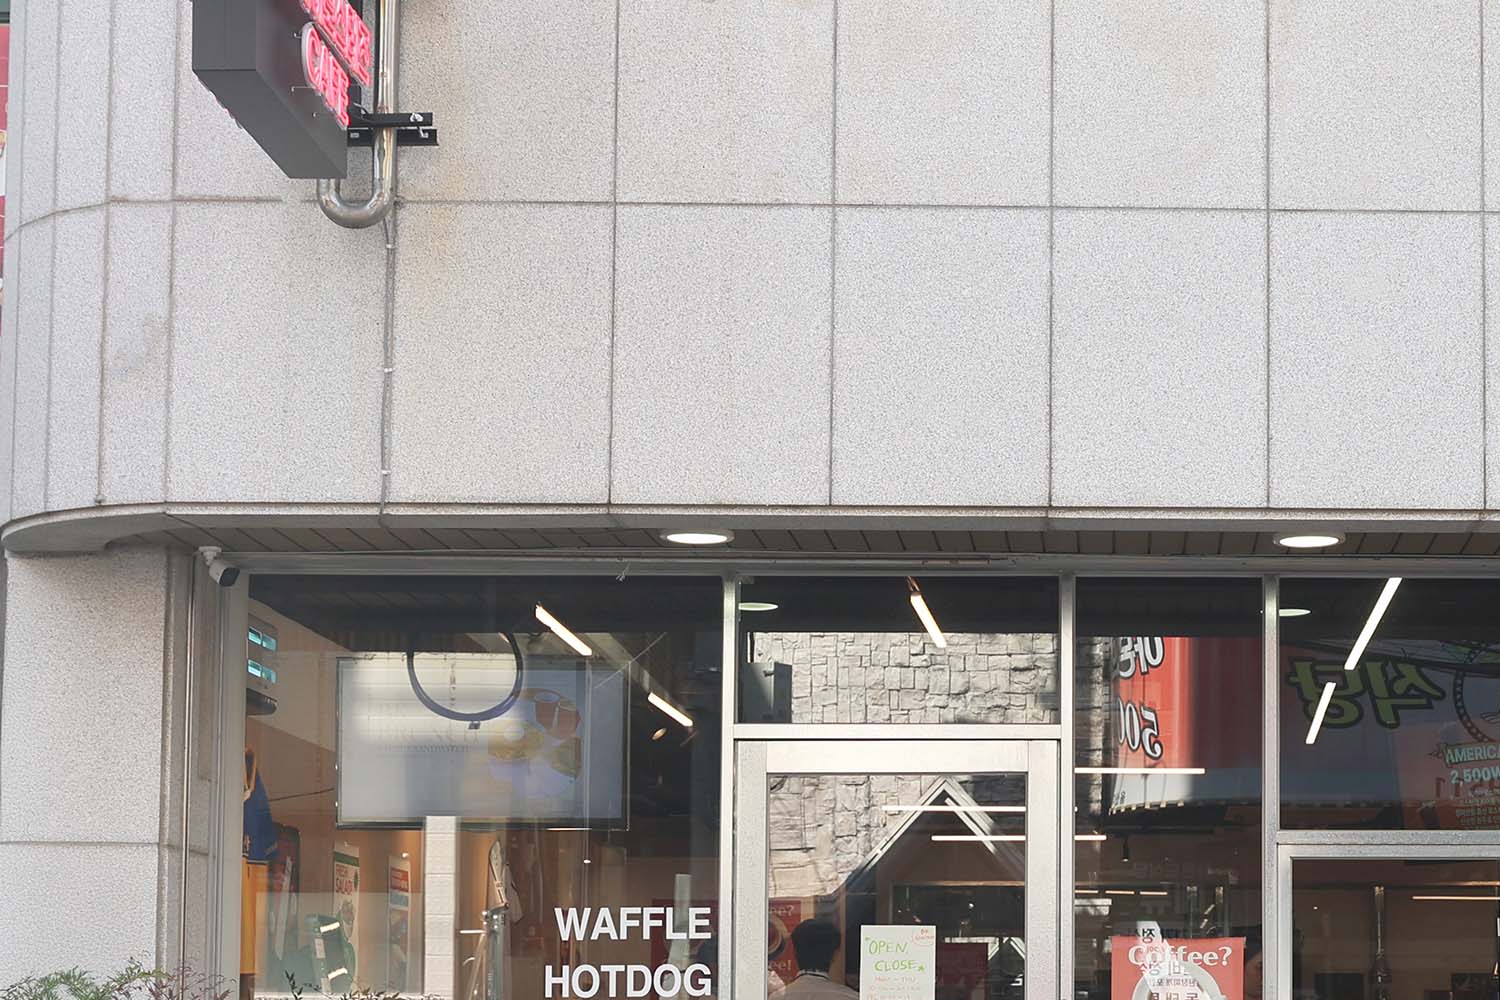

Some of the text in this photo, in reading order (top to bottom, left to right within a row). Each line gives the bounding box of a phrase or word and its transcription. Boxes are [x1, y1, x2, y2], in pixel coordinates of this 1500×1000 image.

[301, 22, 350, 130] CAFE
[554, 907, 712, 941] WAFFLE
[544, 963, 712, 998] HOTDOG
